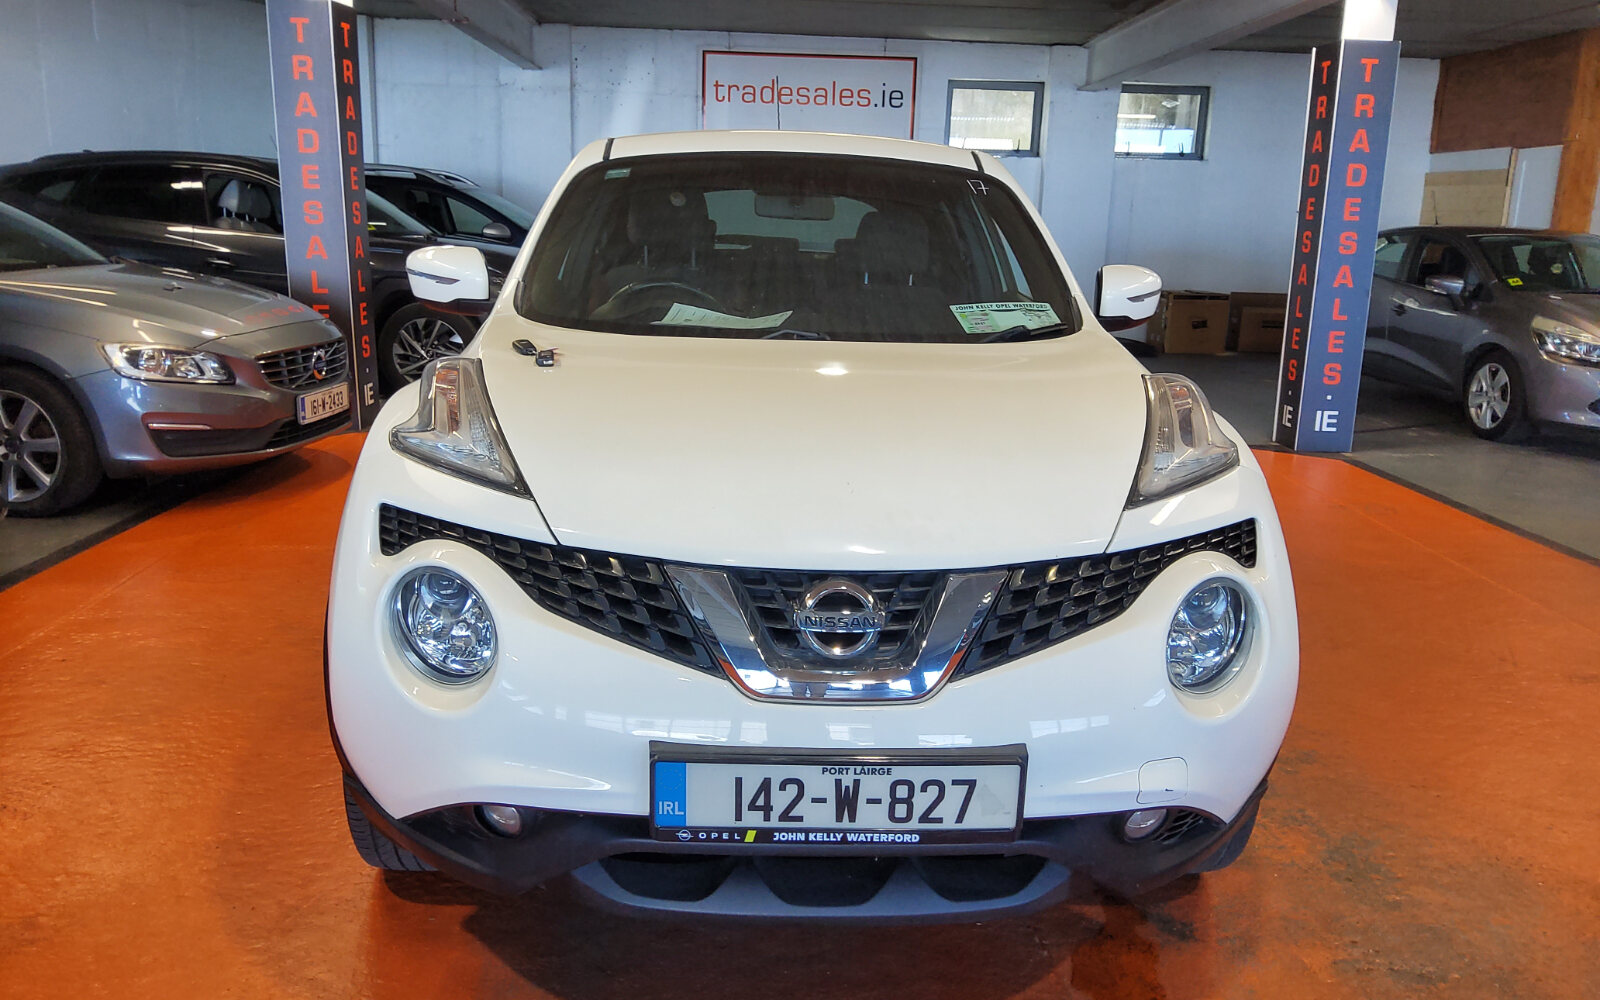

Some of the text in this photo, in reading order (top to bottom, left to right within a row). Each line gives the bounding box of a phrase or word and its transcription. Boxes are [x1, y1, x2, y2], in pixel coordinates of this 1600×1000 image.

[713, 78, 904, 109] tradesales.ie
[804, 615, 876, 628] NISSAN
[821, 765, 893, 777] PORT LÁIRGE
[734, 776, 978, 825] 142-W-827
[658, 801, 685, 815] IRL
[699, 832, 741, 840] OPEL
[773, 832, 920, 843] JOHN KELLY WATERFORD
